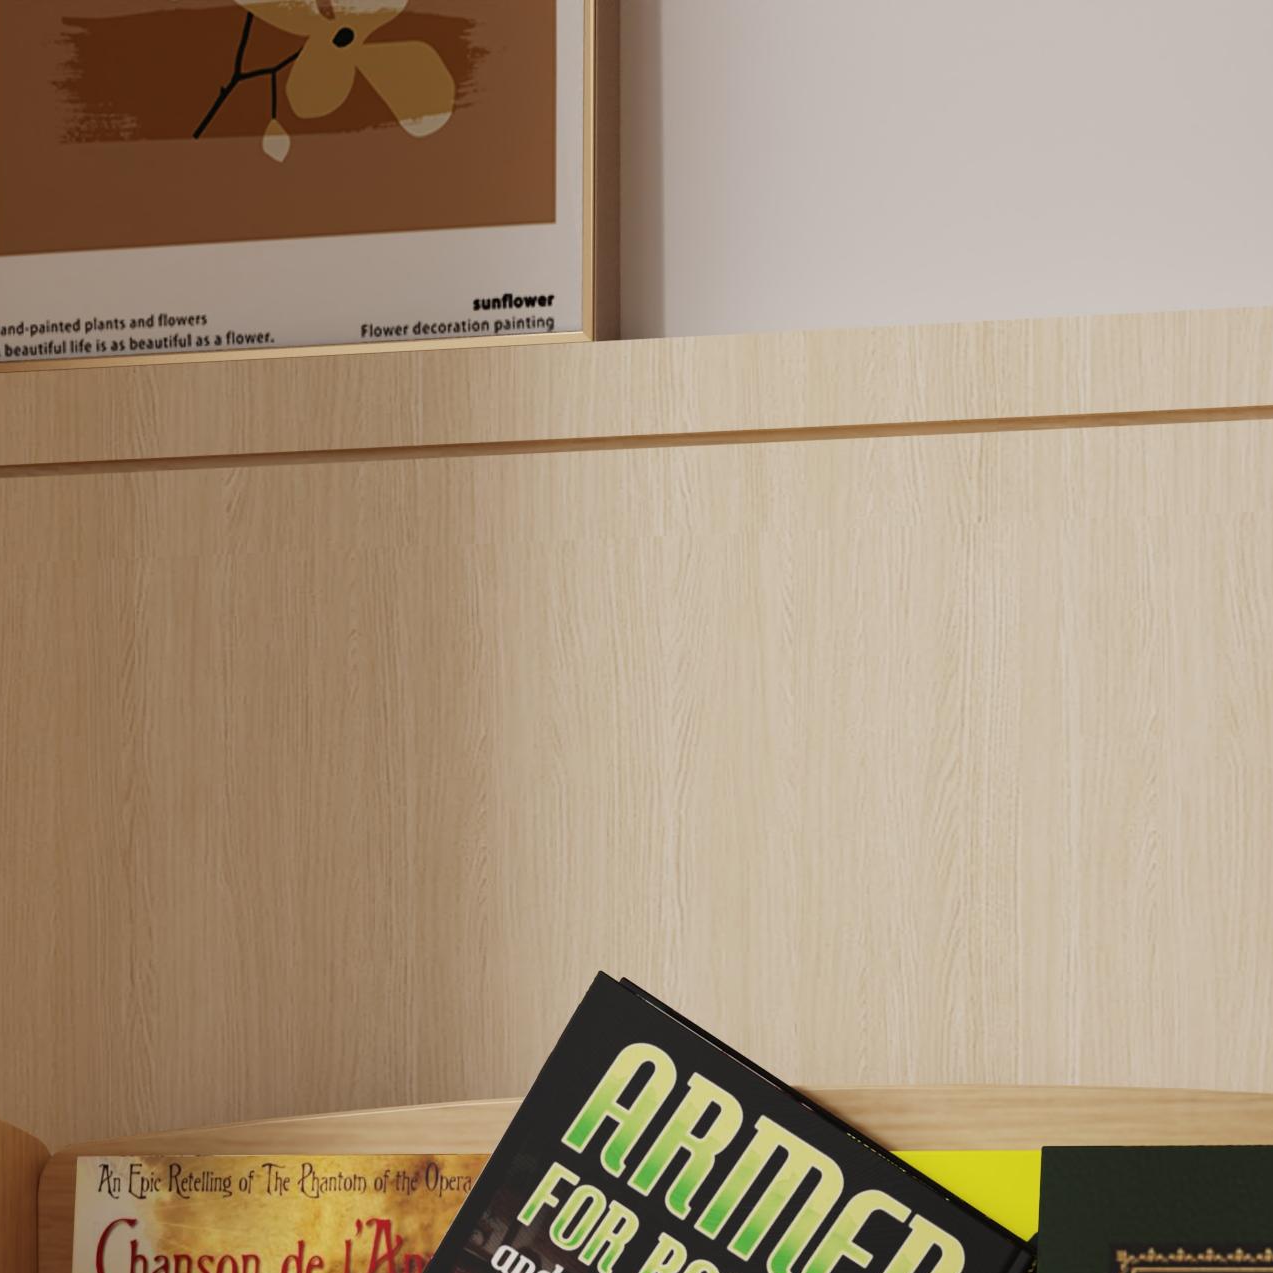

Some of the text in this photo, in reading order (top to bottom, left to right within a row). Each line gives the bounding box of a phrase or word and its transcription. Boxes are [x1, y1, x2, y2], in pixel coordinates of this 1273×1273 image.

[473, 293, 555, 311] sunflower
[85, 317, 125, 334] plants
[129, 314, 155, 329] and
[158, 312, 207, 328] flowers
[360, 315, 555, 338] Flower decoration painting
[4, 339, 67, 357] beautiful
[70, 337, 92, 354] life
[96, 337, 107, 352] is
[110, 338, 126, 352] as
[129, 333, 192, 351] beautiful
[195, 333, 211, 347] as
[214, 333, 223, 346] a
[226, 329, 275, 345] flower.
[98, 1162, 472, 1199] An Epic Retelling of The Phantom of the Opera
